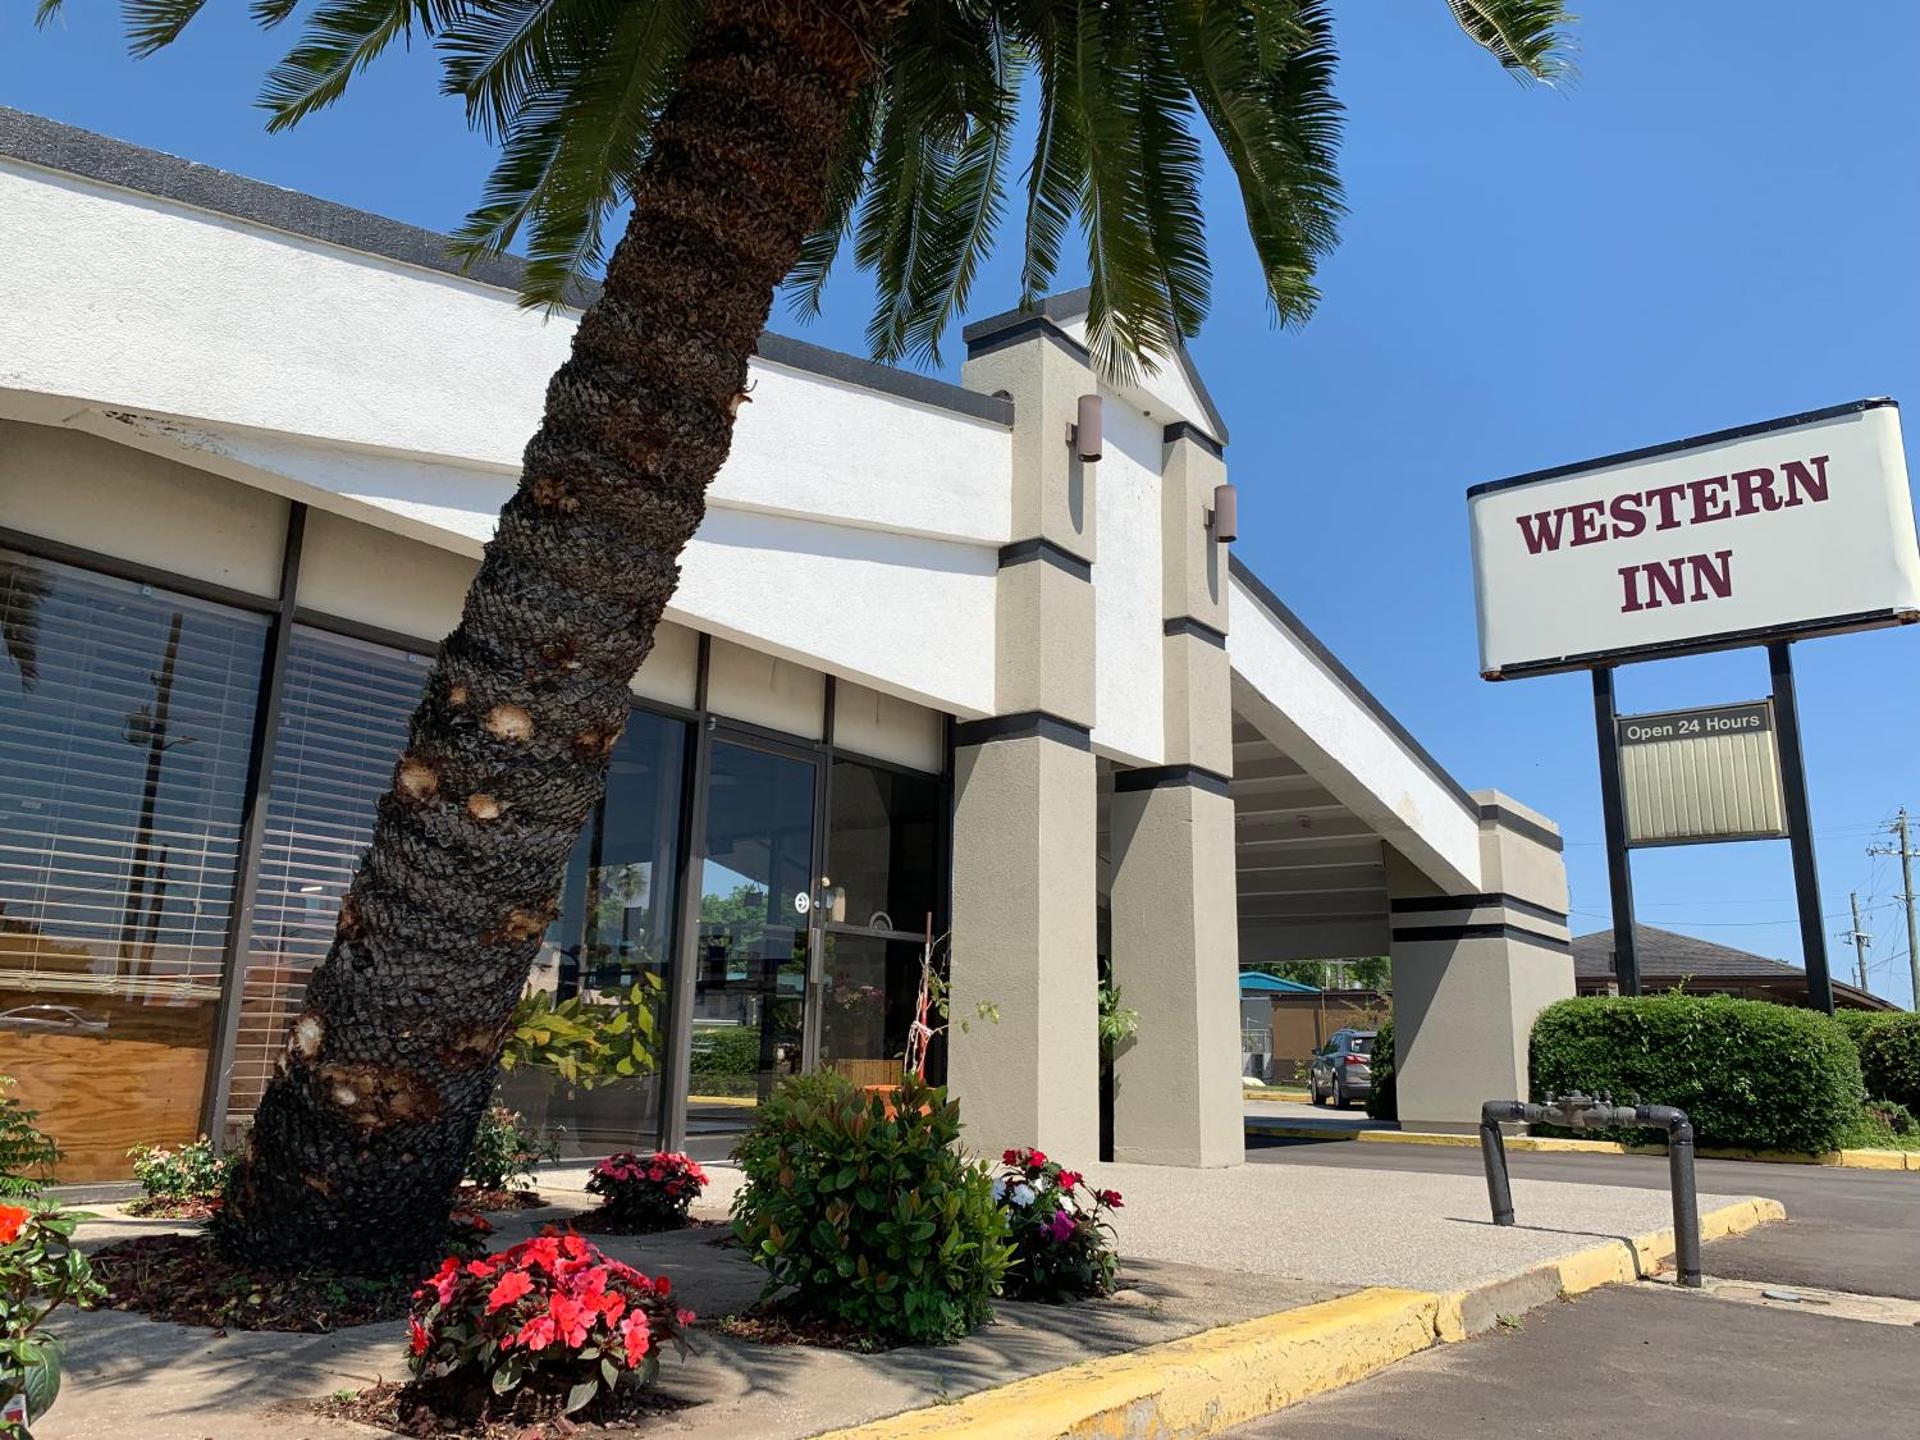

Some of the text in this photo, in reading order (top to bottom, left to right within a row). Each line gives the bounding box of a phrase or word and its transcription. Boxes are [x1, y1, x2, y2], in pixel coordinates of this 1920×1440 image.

[1516, 455, 1829, 555] WESTERN
[1618, 550, 1733, 613] INN
[1627, 715, 1761, 741] Open 24 Hours
